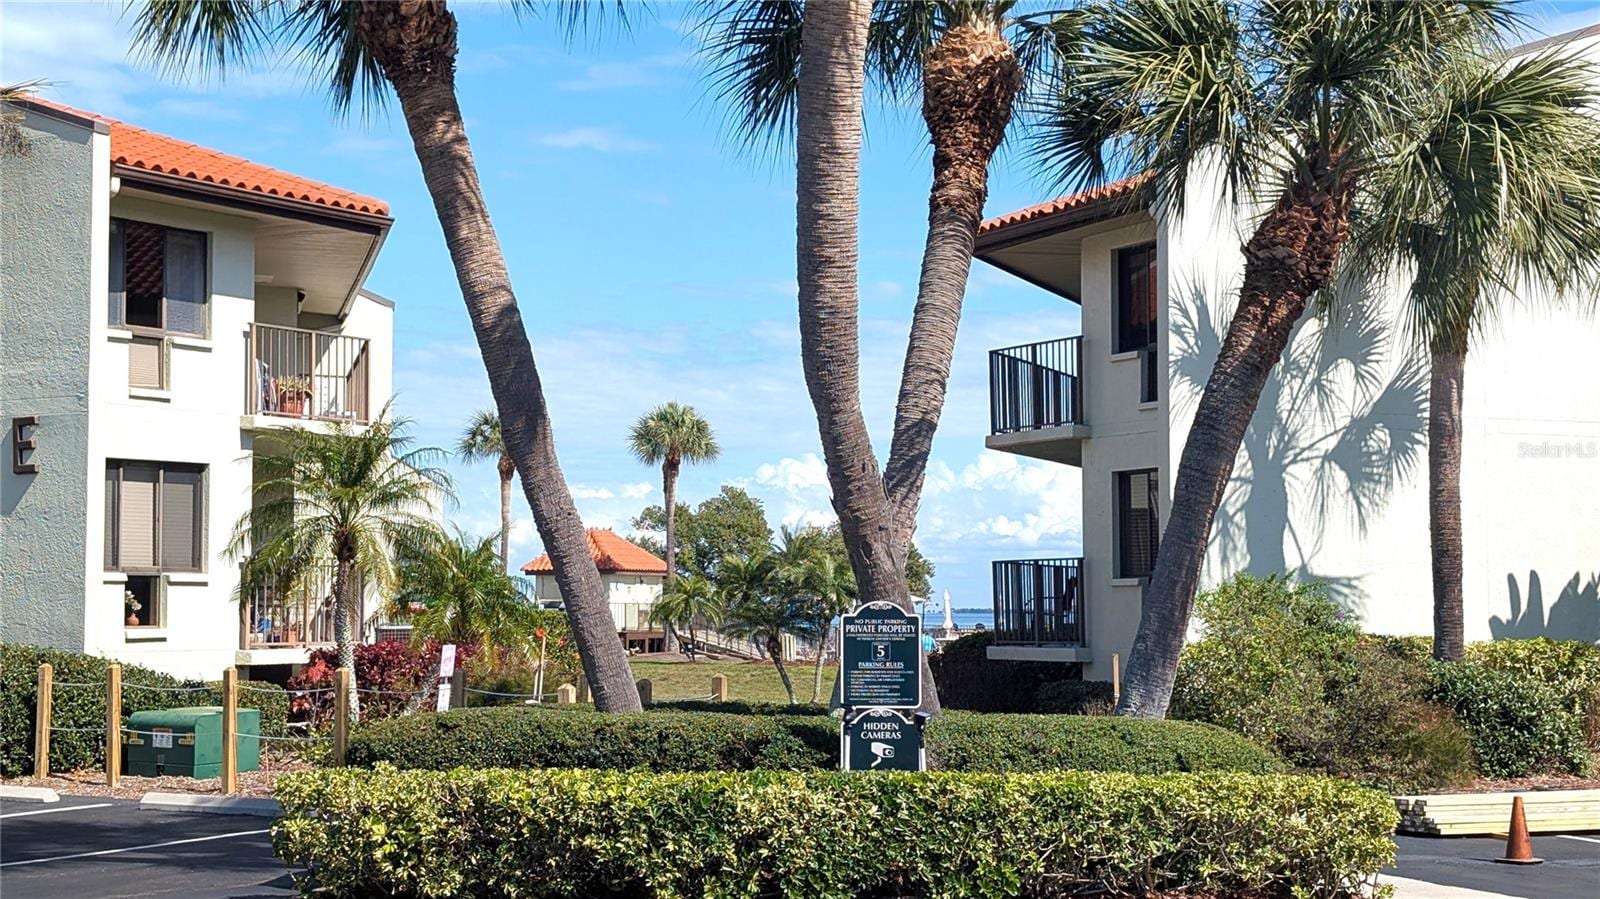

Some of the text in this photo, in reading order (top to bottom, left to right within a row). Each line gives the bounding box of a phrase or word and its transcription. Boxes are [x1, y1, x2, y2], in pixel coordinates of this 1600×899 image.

[12, 416, 39, 474] E
[845, 625, 916, 633] PRIVATE PROPERTY
[876, 645, 885, 657] 5
[863, 722, 899, 730] HIDDEN
[860, 731, 902, 739] CAMERAS
